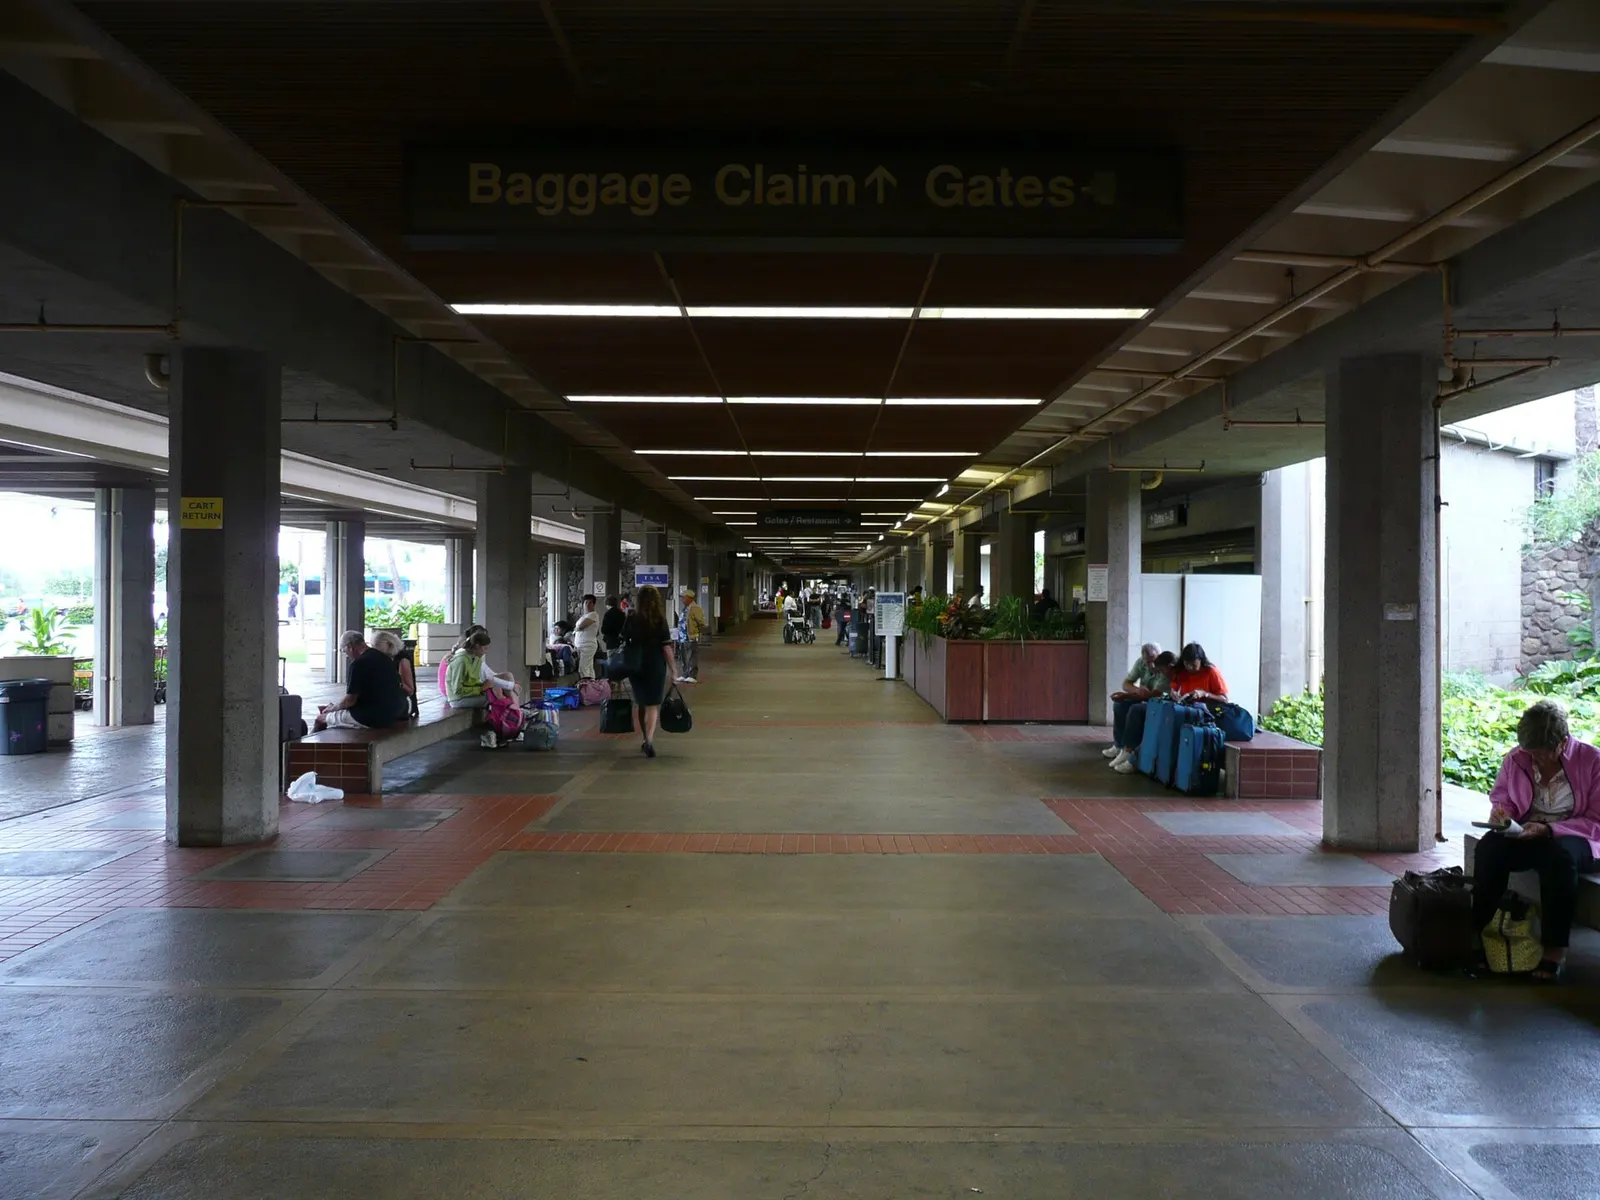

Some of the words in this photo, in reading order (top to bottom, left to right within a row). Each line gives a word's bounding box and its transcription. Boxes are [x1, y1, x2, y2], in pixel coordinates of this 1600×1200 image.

[468, 163, 692, 217] Baggage
[714, 163, 857, 207] Claim
[925, 164, 1075, 208] Gates
[182, 512, 221, 520] RETURN
